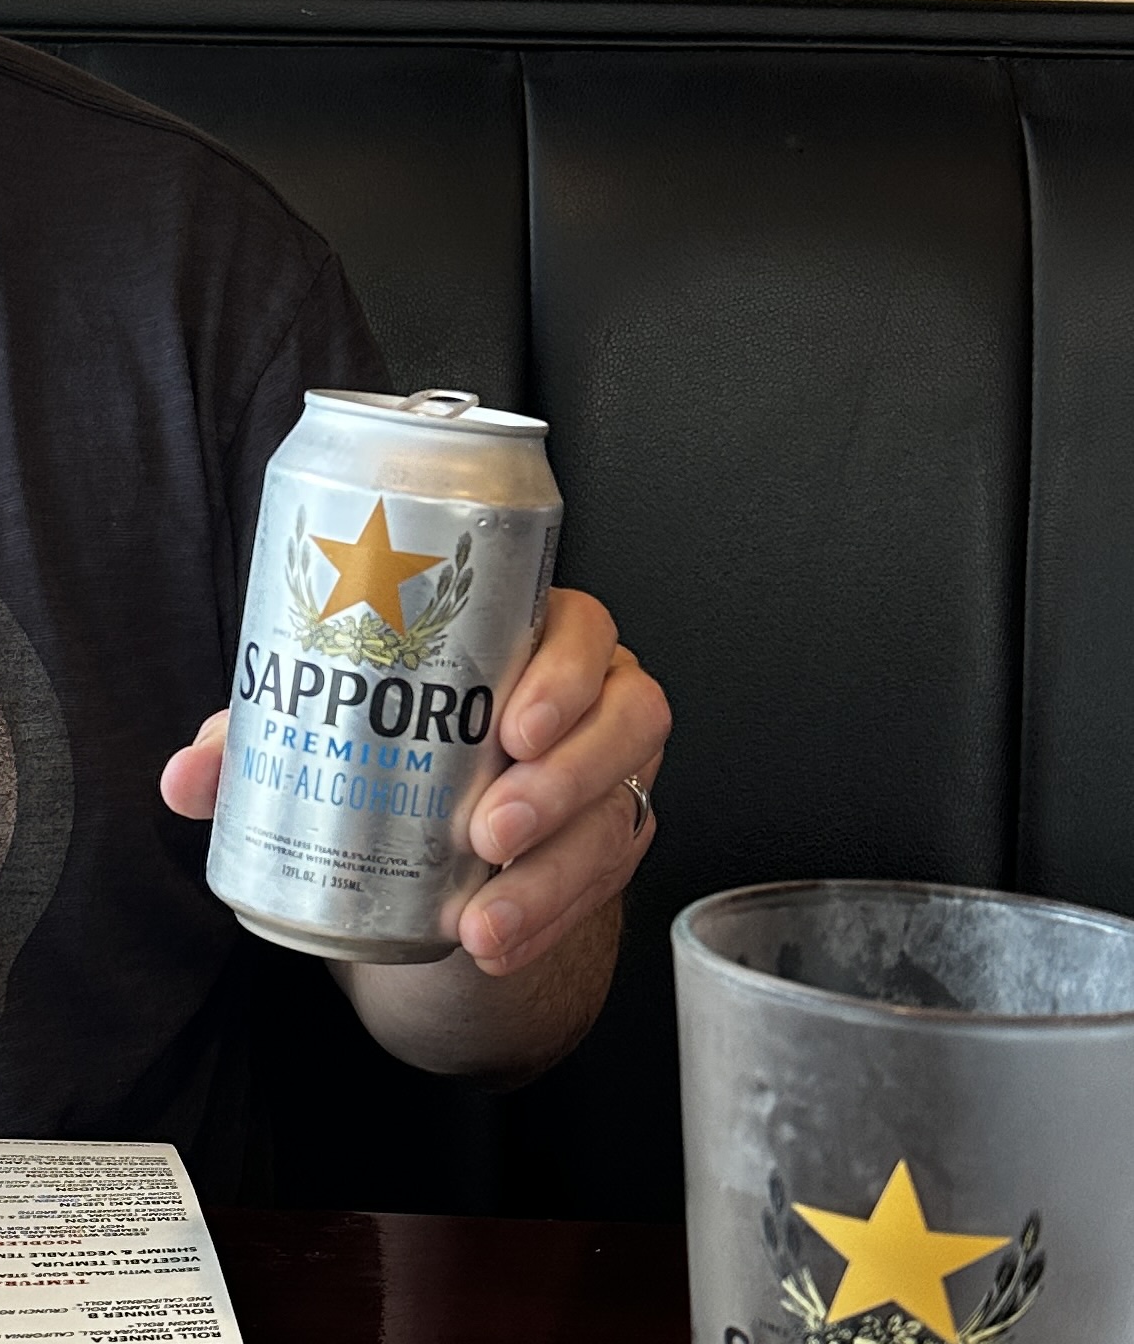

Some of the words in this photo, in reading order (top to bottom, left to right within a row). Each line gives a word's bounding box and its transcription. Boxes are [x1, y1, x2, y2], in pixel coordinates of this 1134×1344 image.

[239, 641, 494, 746] SAPPORO
[264, 719, 434, 774] PREMIUM
[242, 746, 455, 820] NON-ALCOHOLIC
[292, 838, 312, 851] LESS
[314, 843, 340, 857] THAN
[305, 849, 332, 866] WITH
[332, 858, 378, 875] NATURAL
[378, 866, 421, 879] FLAVORS
